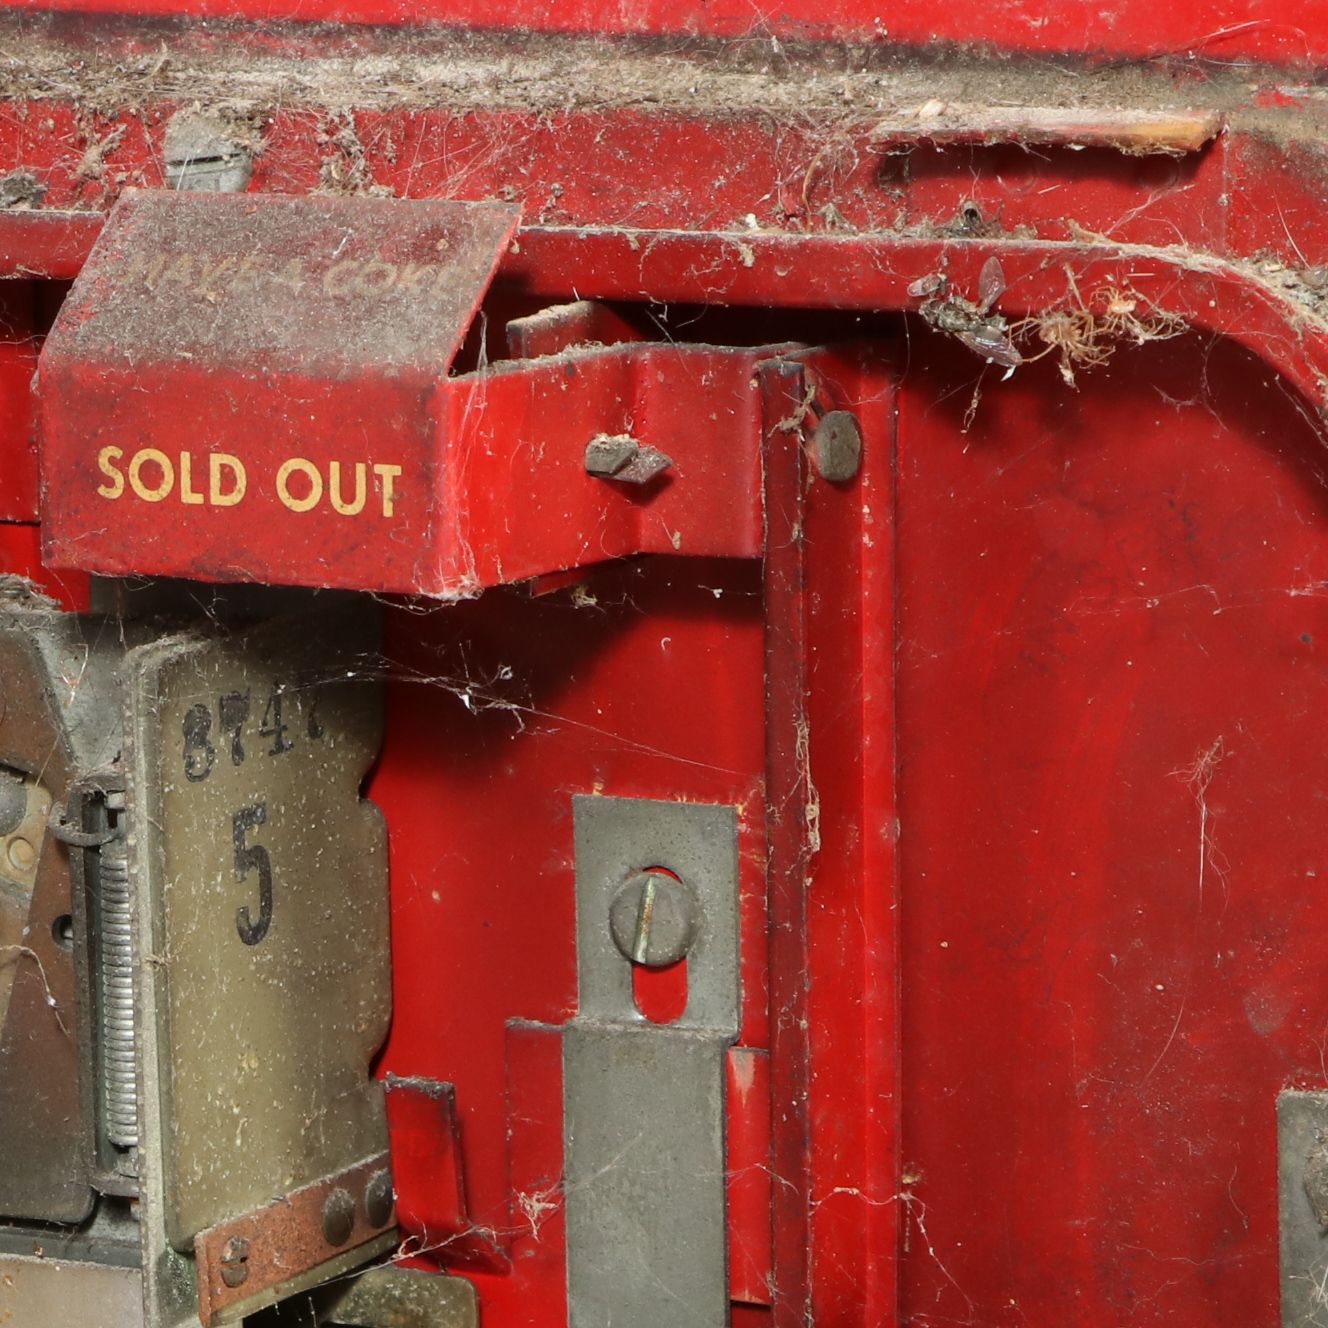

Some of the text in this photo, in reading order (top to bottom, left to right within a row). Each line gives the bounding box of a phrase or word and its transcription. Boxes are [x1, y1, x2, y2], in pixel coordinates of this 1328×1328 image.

[97, 445, 402, 517] SOLD OUT
[232, 803, 272, 945] 5
